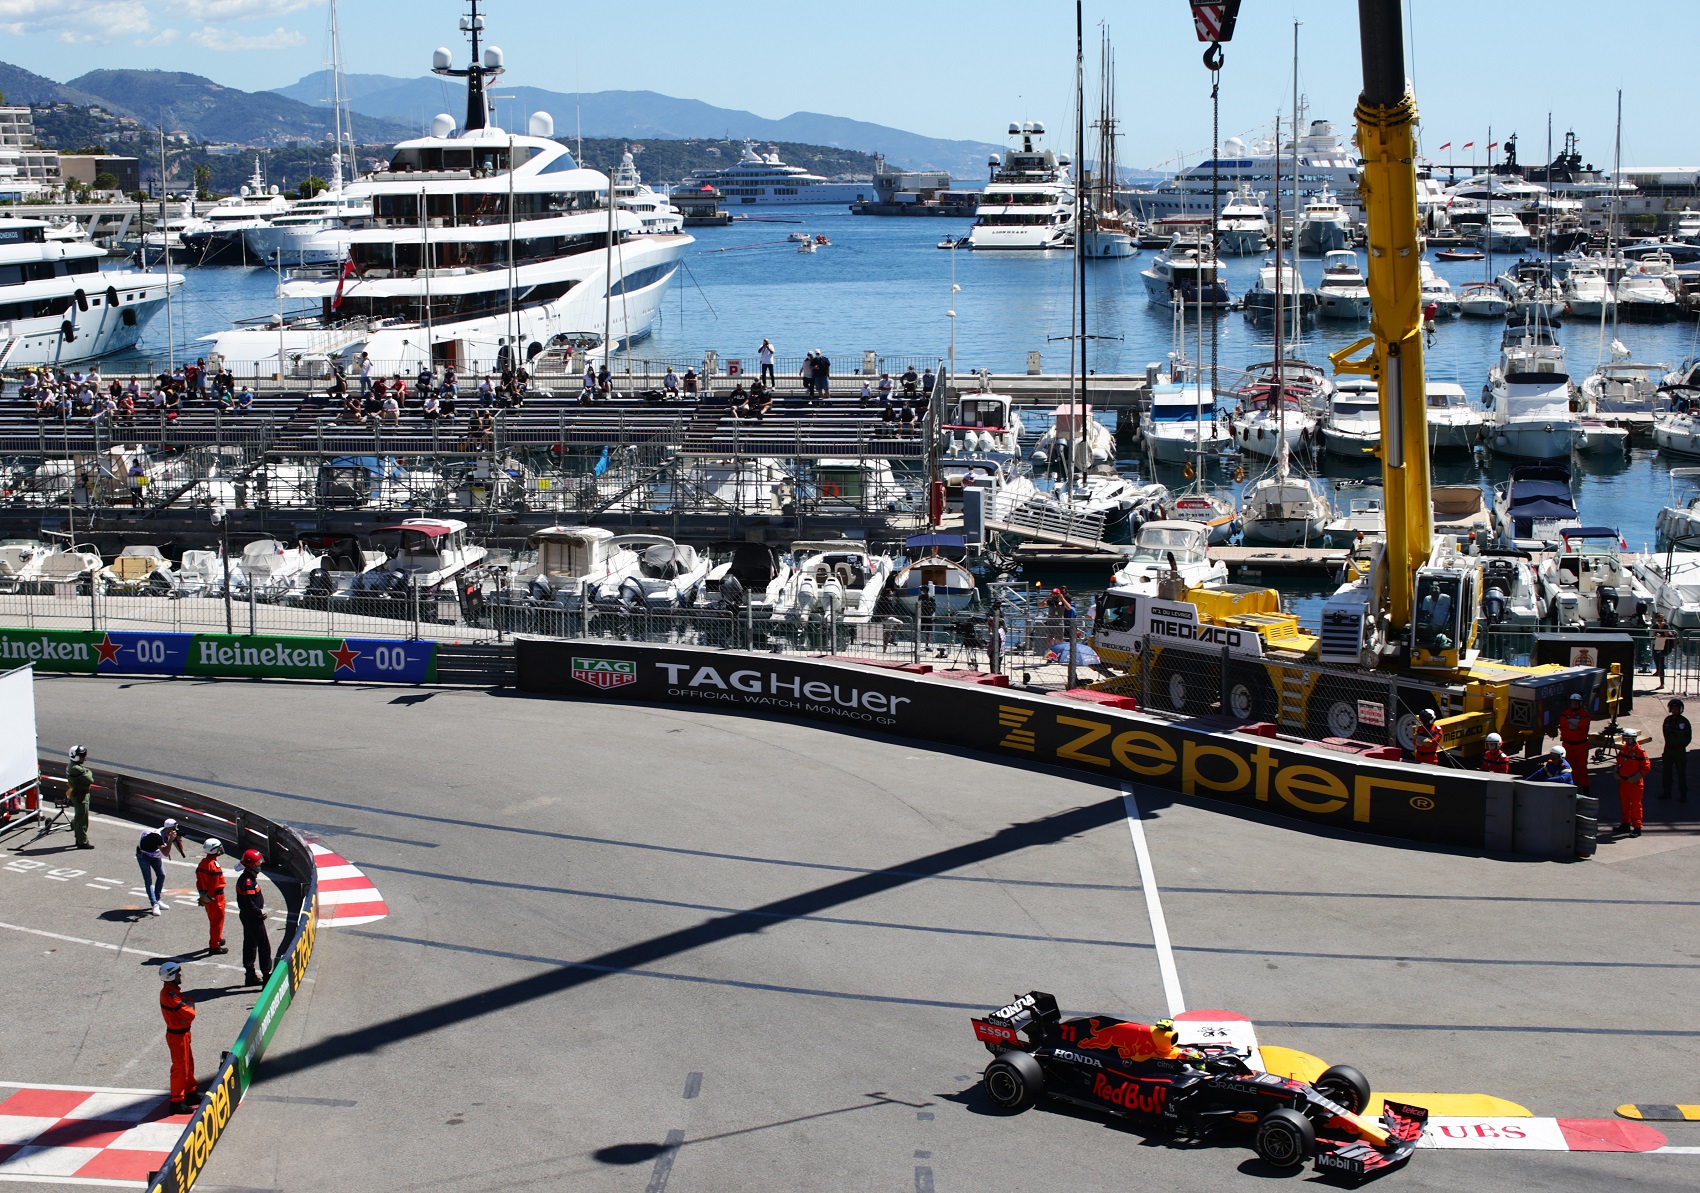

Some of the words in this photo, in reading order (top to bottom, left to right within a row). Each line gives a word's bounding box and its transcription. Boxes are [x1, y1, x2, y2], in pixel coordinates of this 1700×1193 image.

[729, 365, 739, 376] P
[1171, 611, 1192, 619] LEVAGE
[0, 635, 89, 660] ineken
[199, 641, 325, 667] Heineken
[576, 658, 633, 672] TAG
[575, 671, 634, 689] HEUER
[668, 688, 740, 702] OFFICIAL
[744, 695, 801, 710] WATCH
[805, 703, 873, 722] MONACO
[877, 716, 897, 726] GP
[1056, 715, 1436, 823] zepter
[992, 994, 1036, 1019] HONDA
[1059, 1024, 1077, 1043] 11
[1053, 1048, 1103, 1068] HONDA
[1207, 1080, 1258, 1095] ORACLE
[1401, 1105, 1427, 1117] telcel
[183, 1064, 234, 1190] zepter
[1439, 1123, 1527, 1140] UBS
[1318, 1154, 1349, 1170] Mobil
